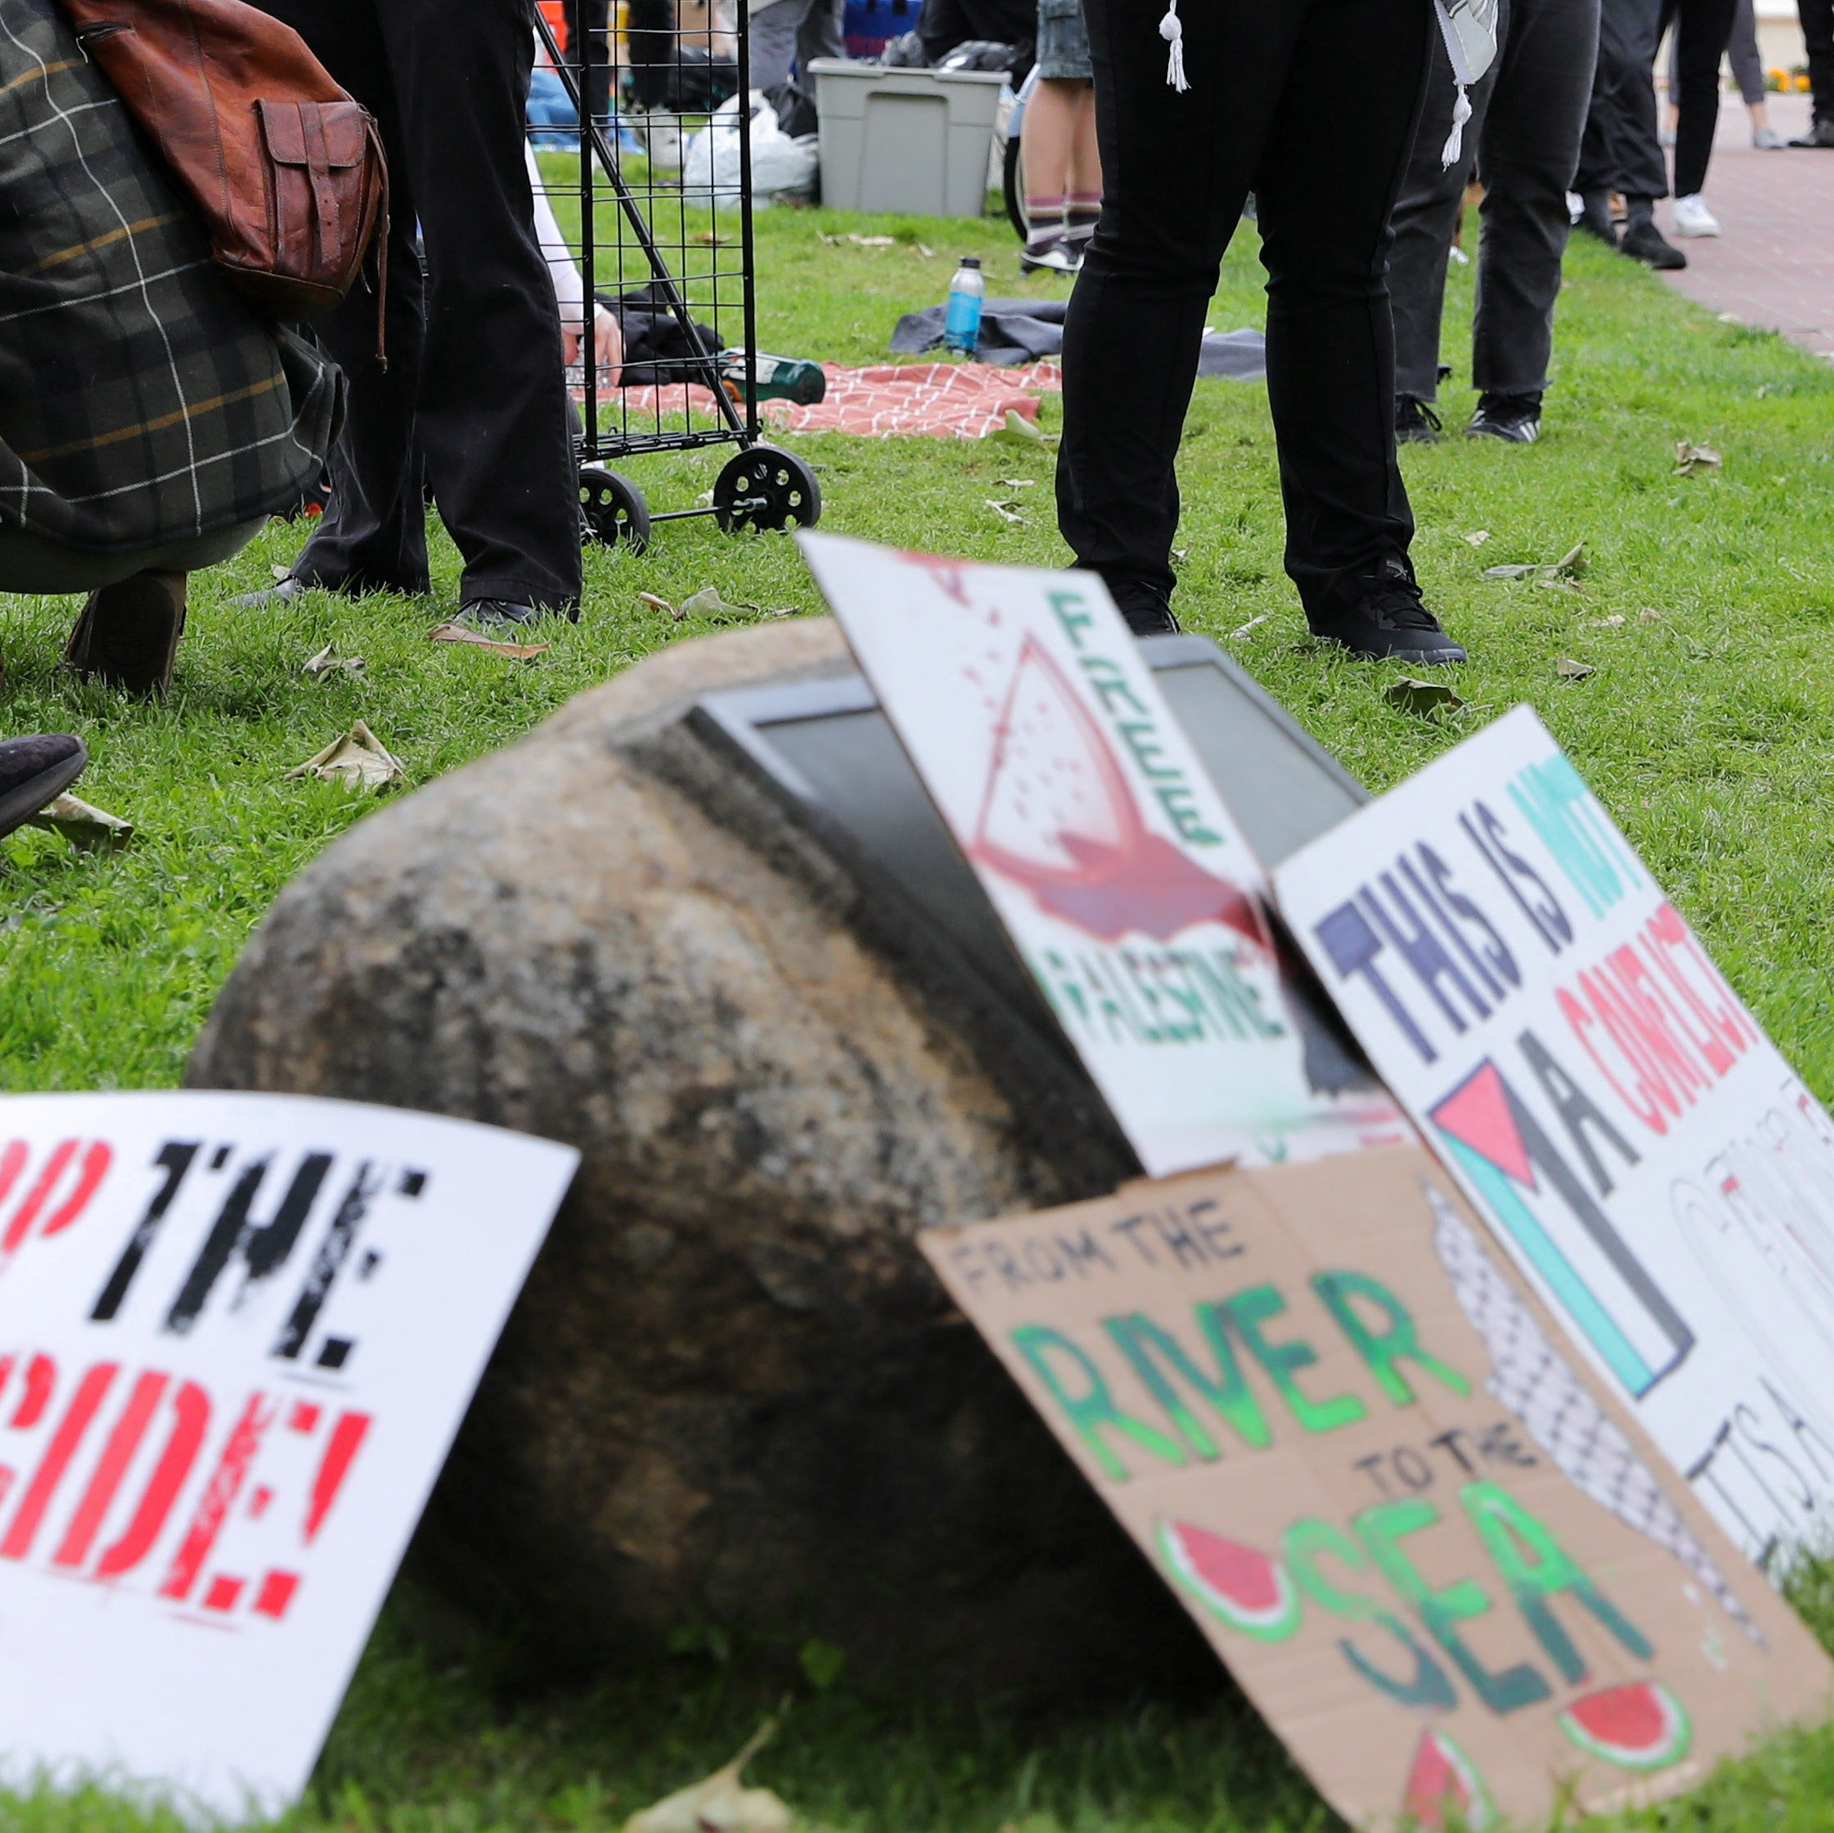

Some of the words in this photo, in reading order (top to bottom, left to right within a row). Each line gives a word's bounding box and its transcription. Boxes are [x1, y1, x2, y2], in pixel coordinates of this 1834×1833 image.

[1044, 586, 1225, 849] FREE
[1456, 798, 1575, 957] IS
[1506, 753, 1647, 921] NOT
[1311, 838, 1524, 1066] THIS
[1554, 902, 1761, 1137] CONFLICT
[1516, 1028, 1642, 1201] A
[85, 1139, 429, 1372] THE
[950, 1226, 1118, 1298] FROM
[1120, 1196, 1248, 1272] THE
[1009, 1267, 1473, 1482] RIVER
[1354, 1446, 1436, 1495] TO
[1433, 1420, 1540, 1484] THE
[1278, 1479, 1657, 1716] SEA
